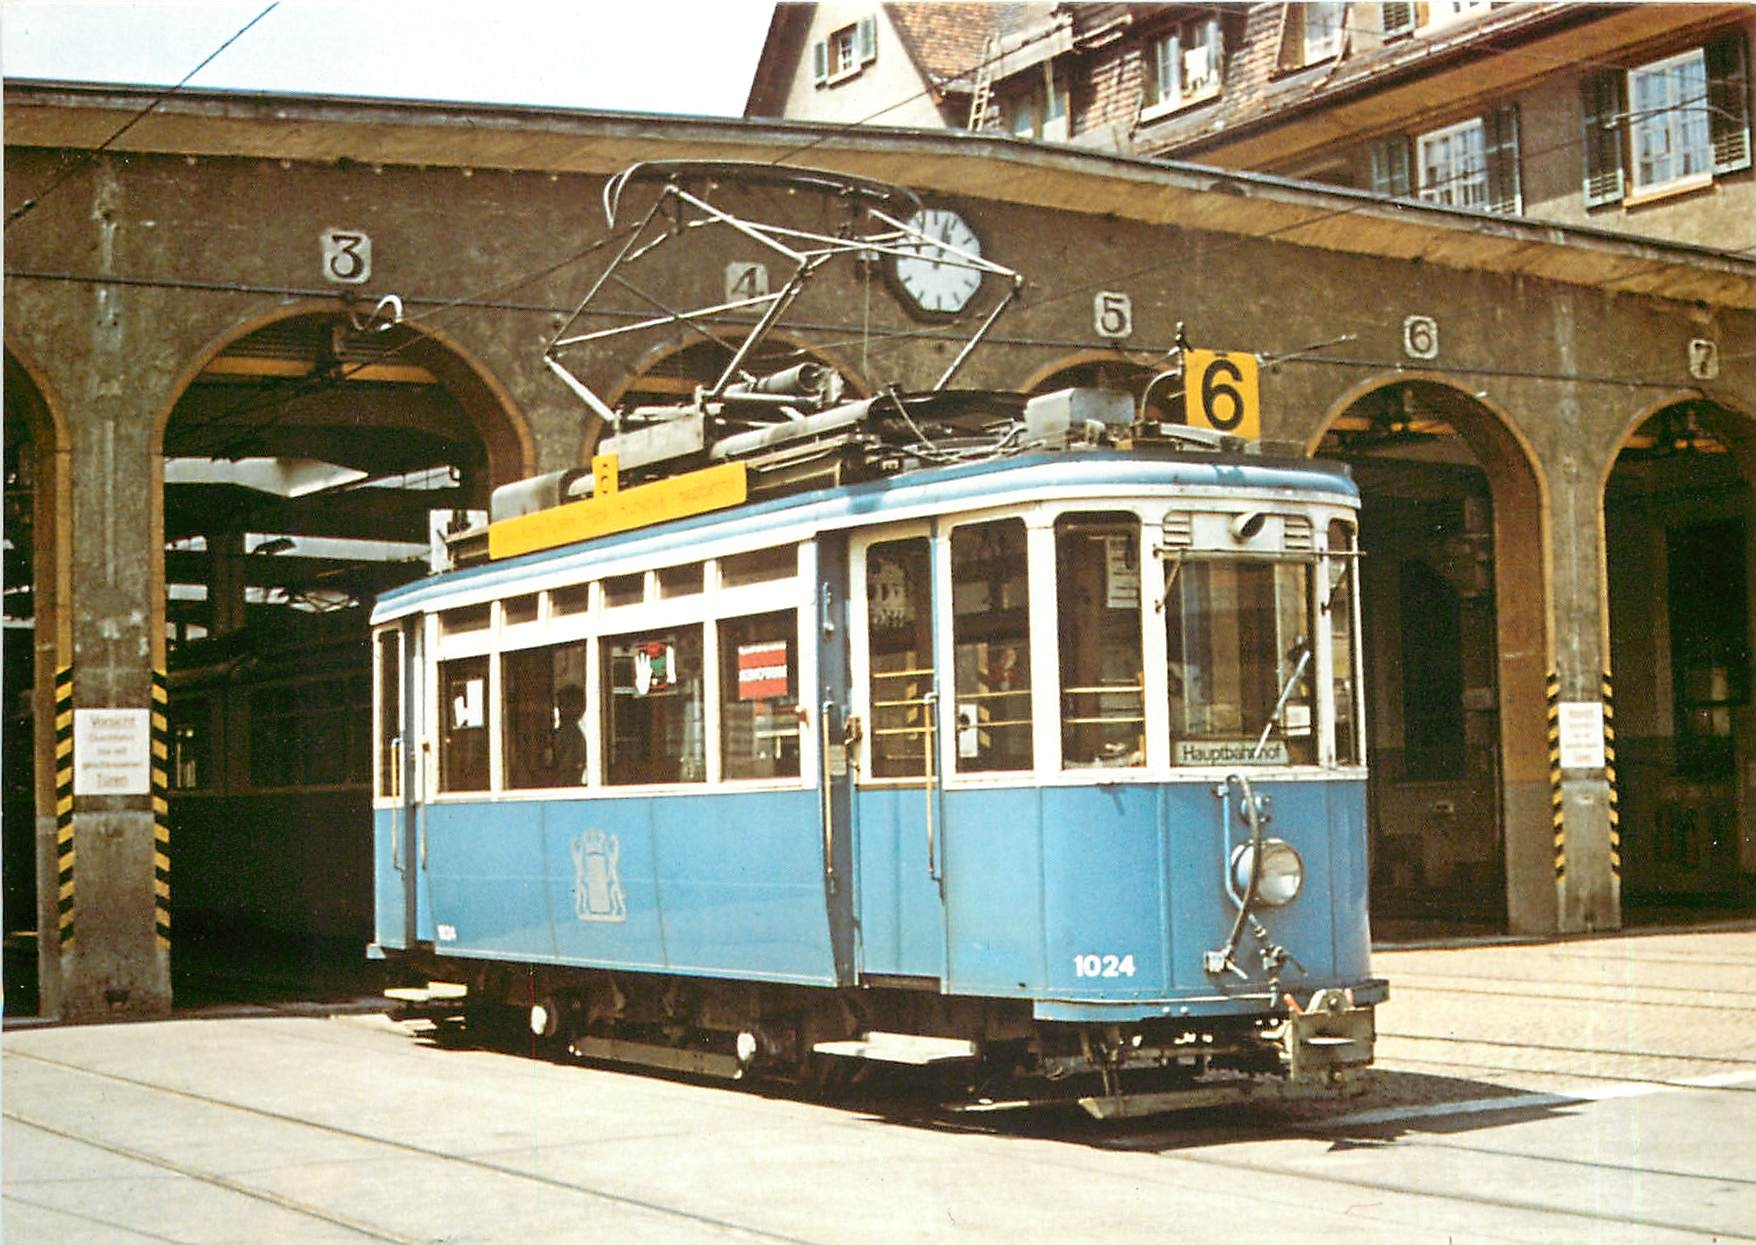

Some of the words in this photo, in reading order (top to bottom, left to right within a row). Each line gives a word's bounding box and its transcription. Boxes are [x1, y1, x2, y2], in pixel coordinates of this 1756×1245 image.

[331, 235, 364, 279] 3
[731, 267, 764, 309] 4
[1101, 296, 1126, 333] 5
[1409, 319, 1431, 354] 6
[1694, 343, 1712, 376] 7
[1202, 359, 1244, 431] 6
[1073, 954, 1136, 977] 1024
